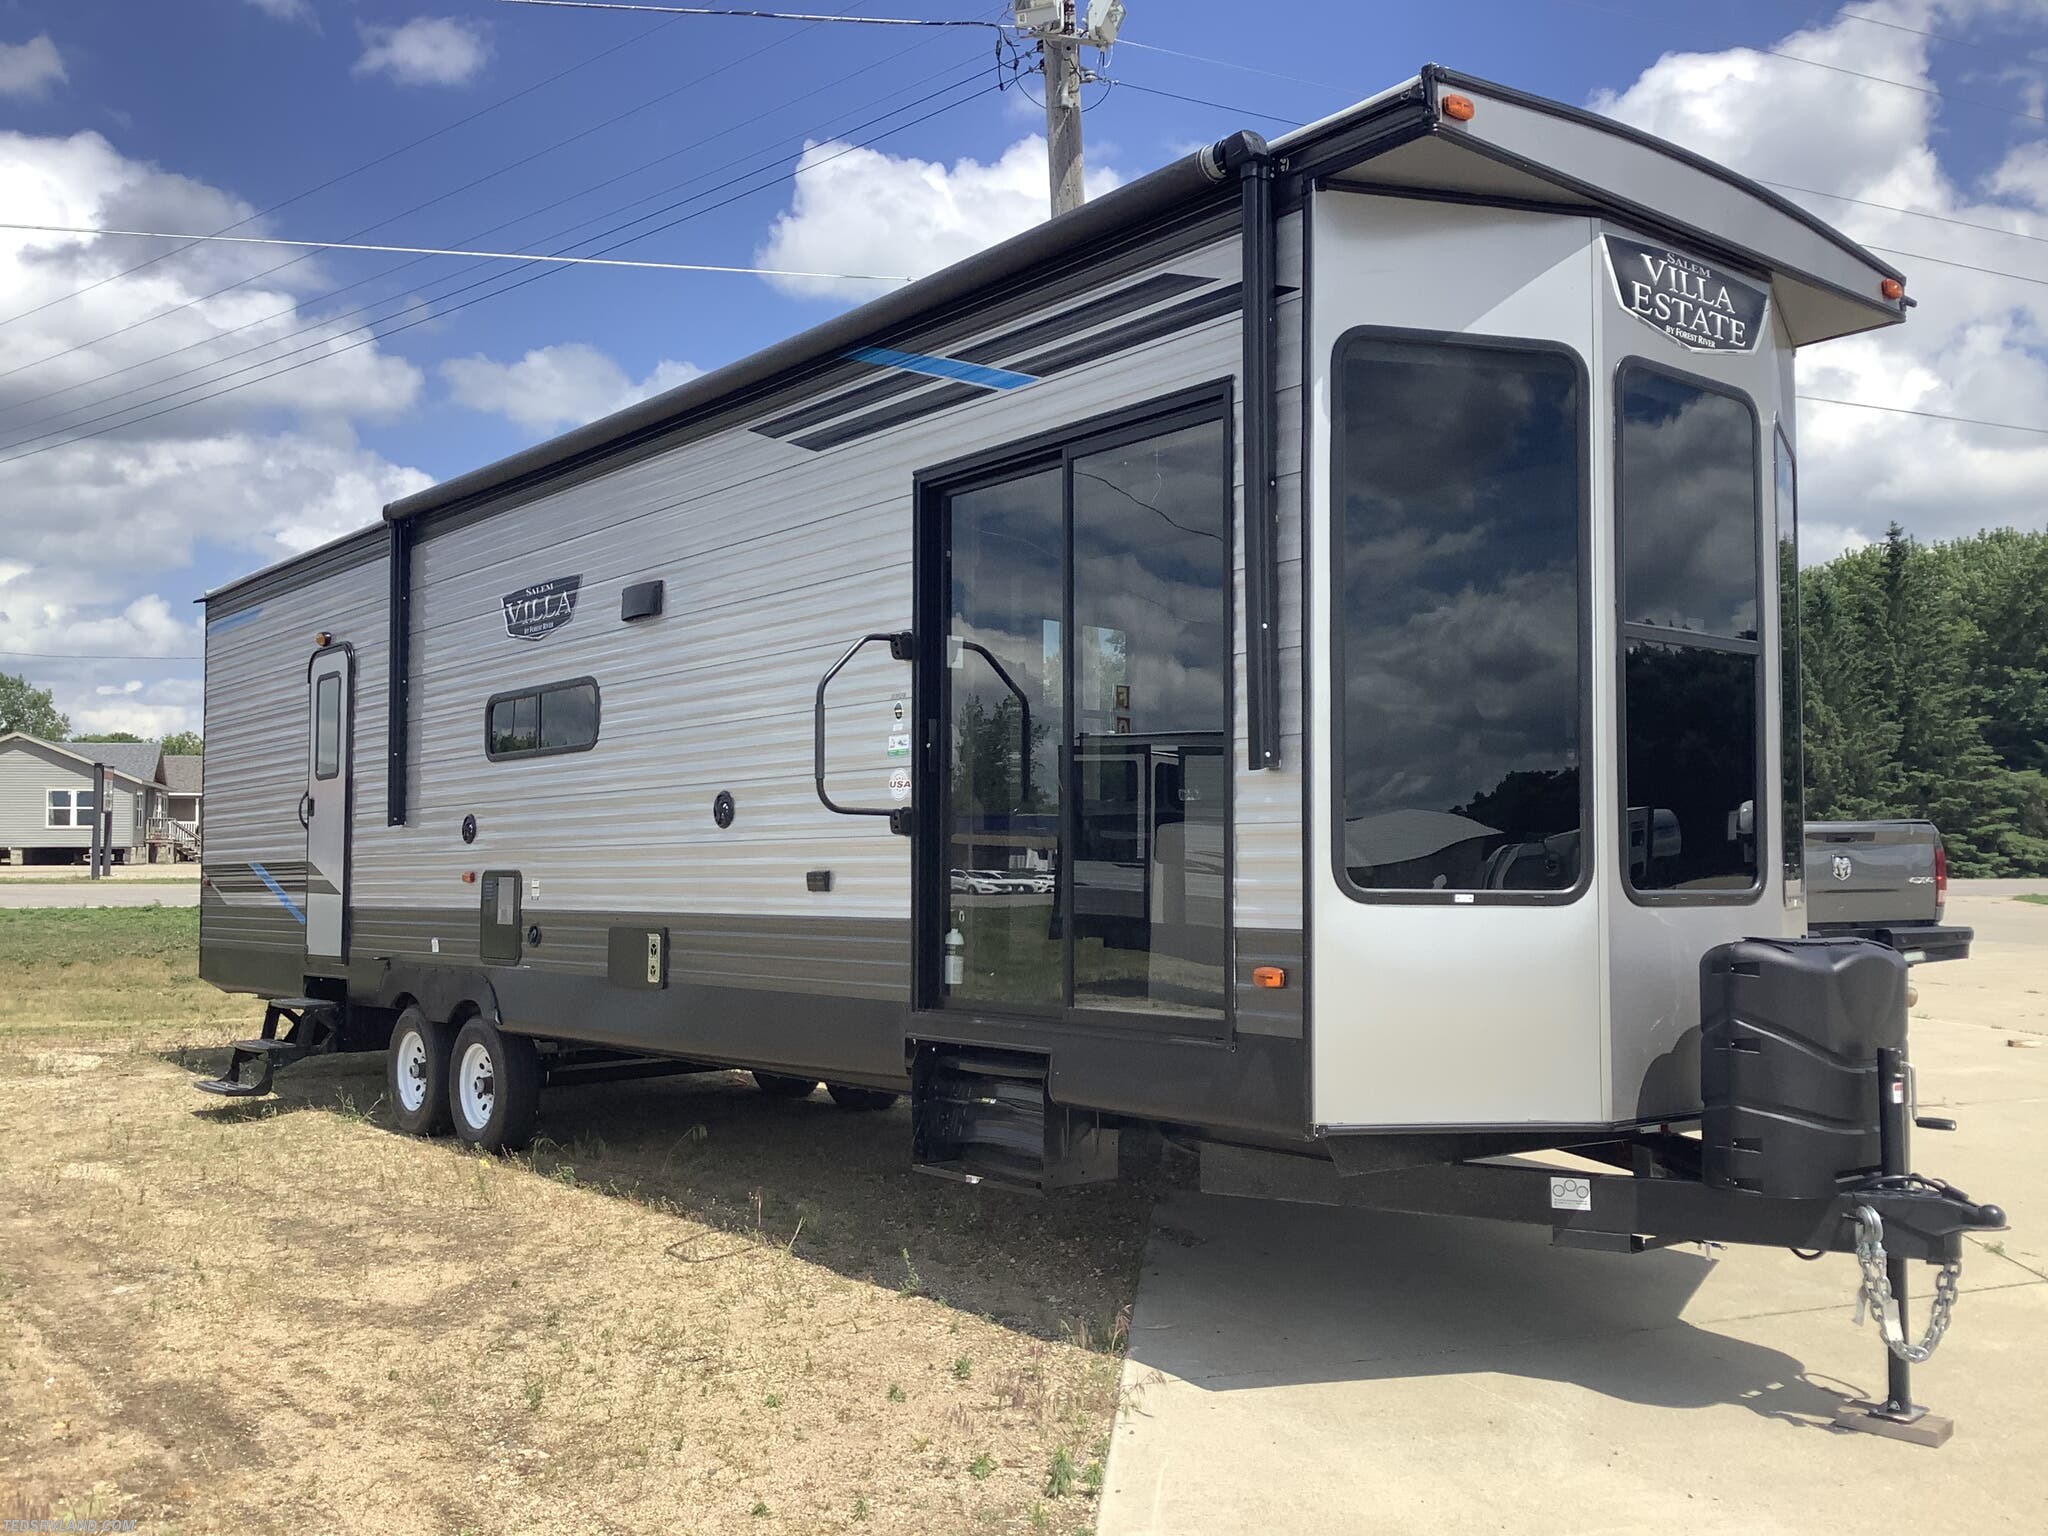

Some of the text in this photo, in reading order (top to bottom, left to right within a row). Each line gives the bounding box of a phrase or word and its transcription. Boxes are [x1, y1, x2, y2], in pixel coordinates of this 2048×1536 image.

[1666, 252, 1712, 279] SALEM
[1640, 253, 1736, 314] VILLA
[1631, 280, 1747, 347] ESTATE
[1665, 324, 1716, 348] BY FOREST RIVER
[525, 583, 554, 596] SALEM
[505, 590, 571, 625] VILLA
[889, 780, 911, 788] USA
